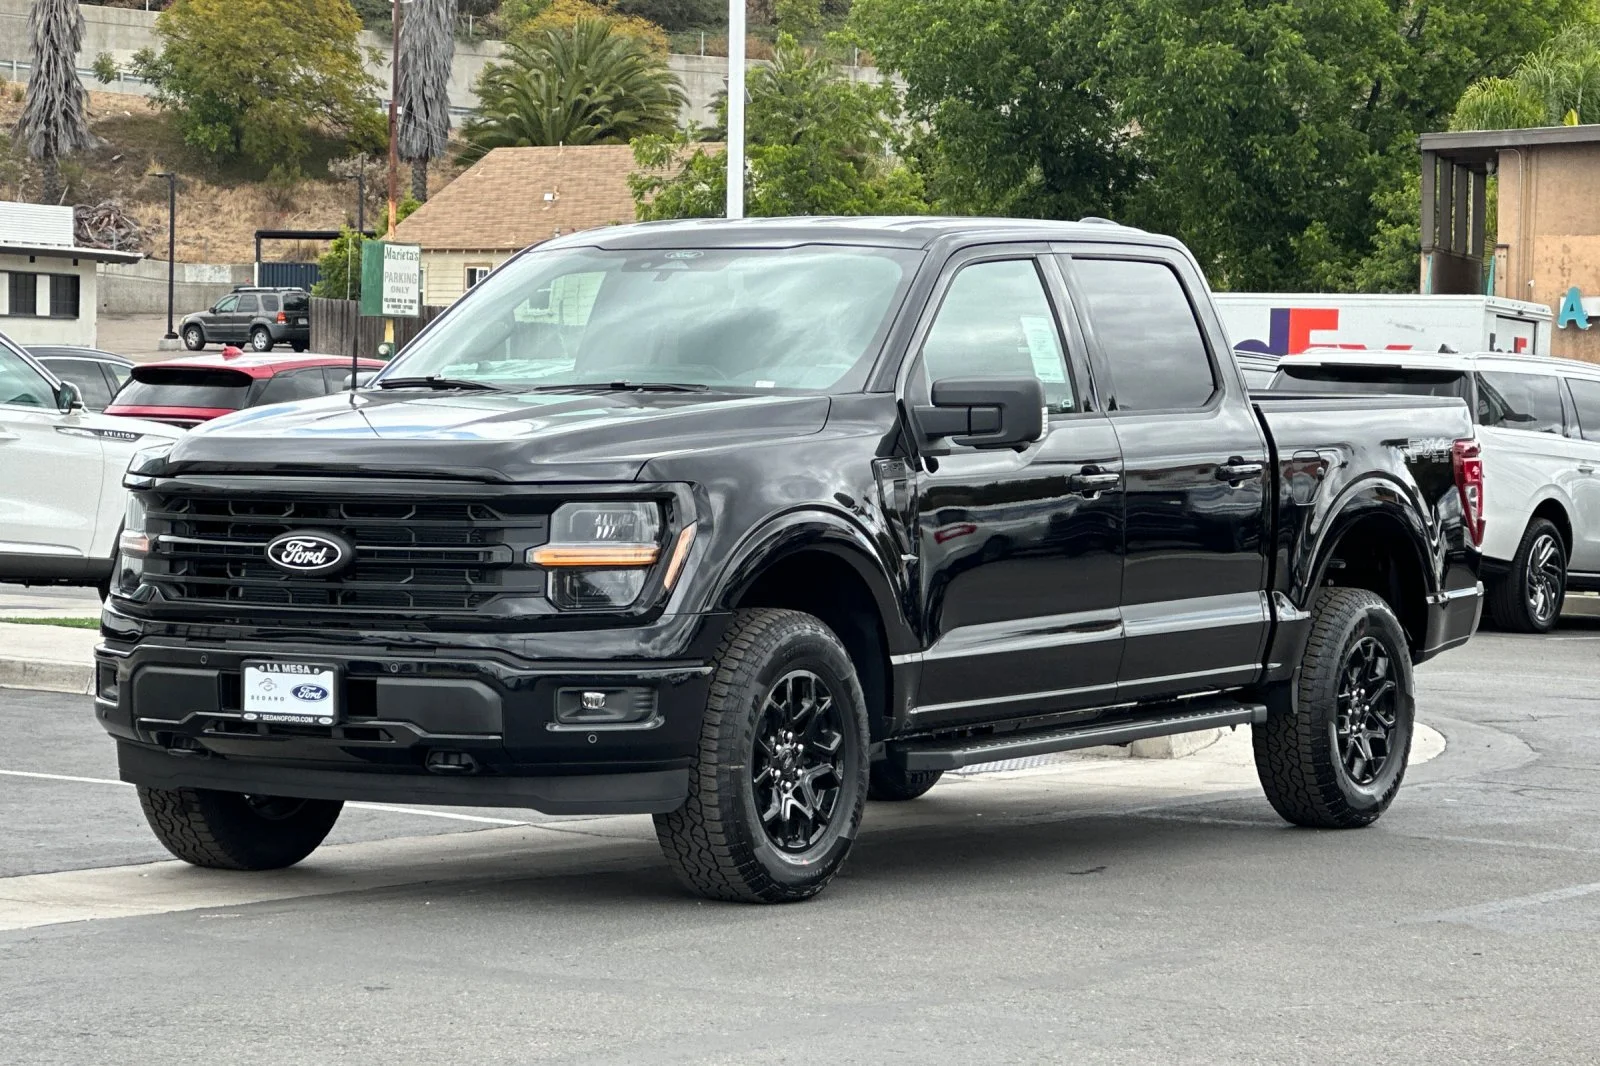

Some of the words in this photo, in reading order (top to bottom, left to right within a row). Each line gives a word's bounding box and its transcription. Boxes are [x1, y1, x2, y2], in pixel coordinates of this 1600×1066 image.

[385, 272, 417, 284] PARKING
[391, 286, 409, 294] ONLY
[281, 540, 328, 564] Ford
[267, 664, 280, 673] LA
[282, 665, 310, 674] MESA
[298, 686, 322, 699] Ford
